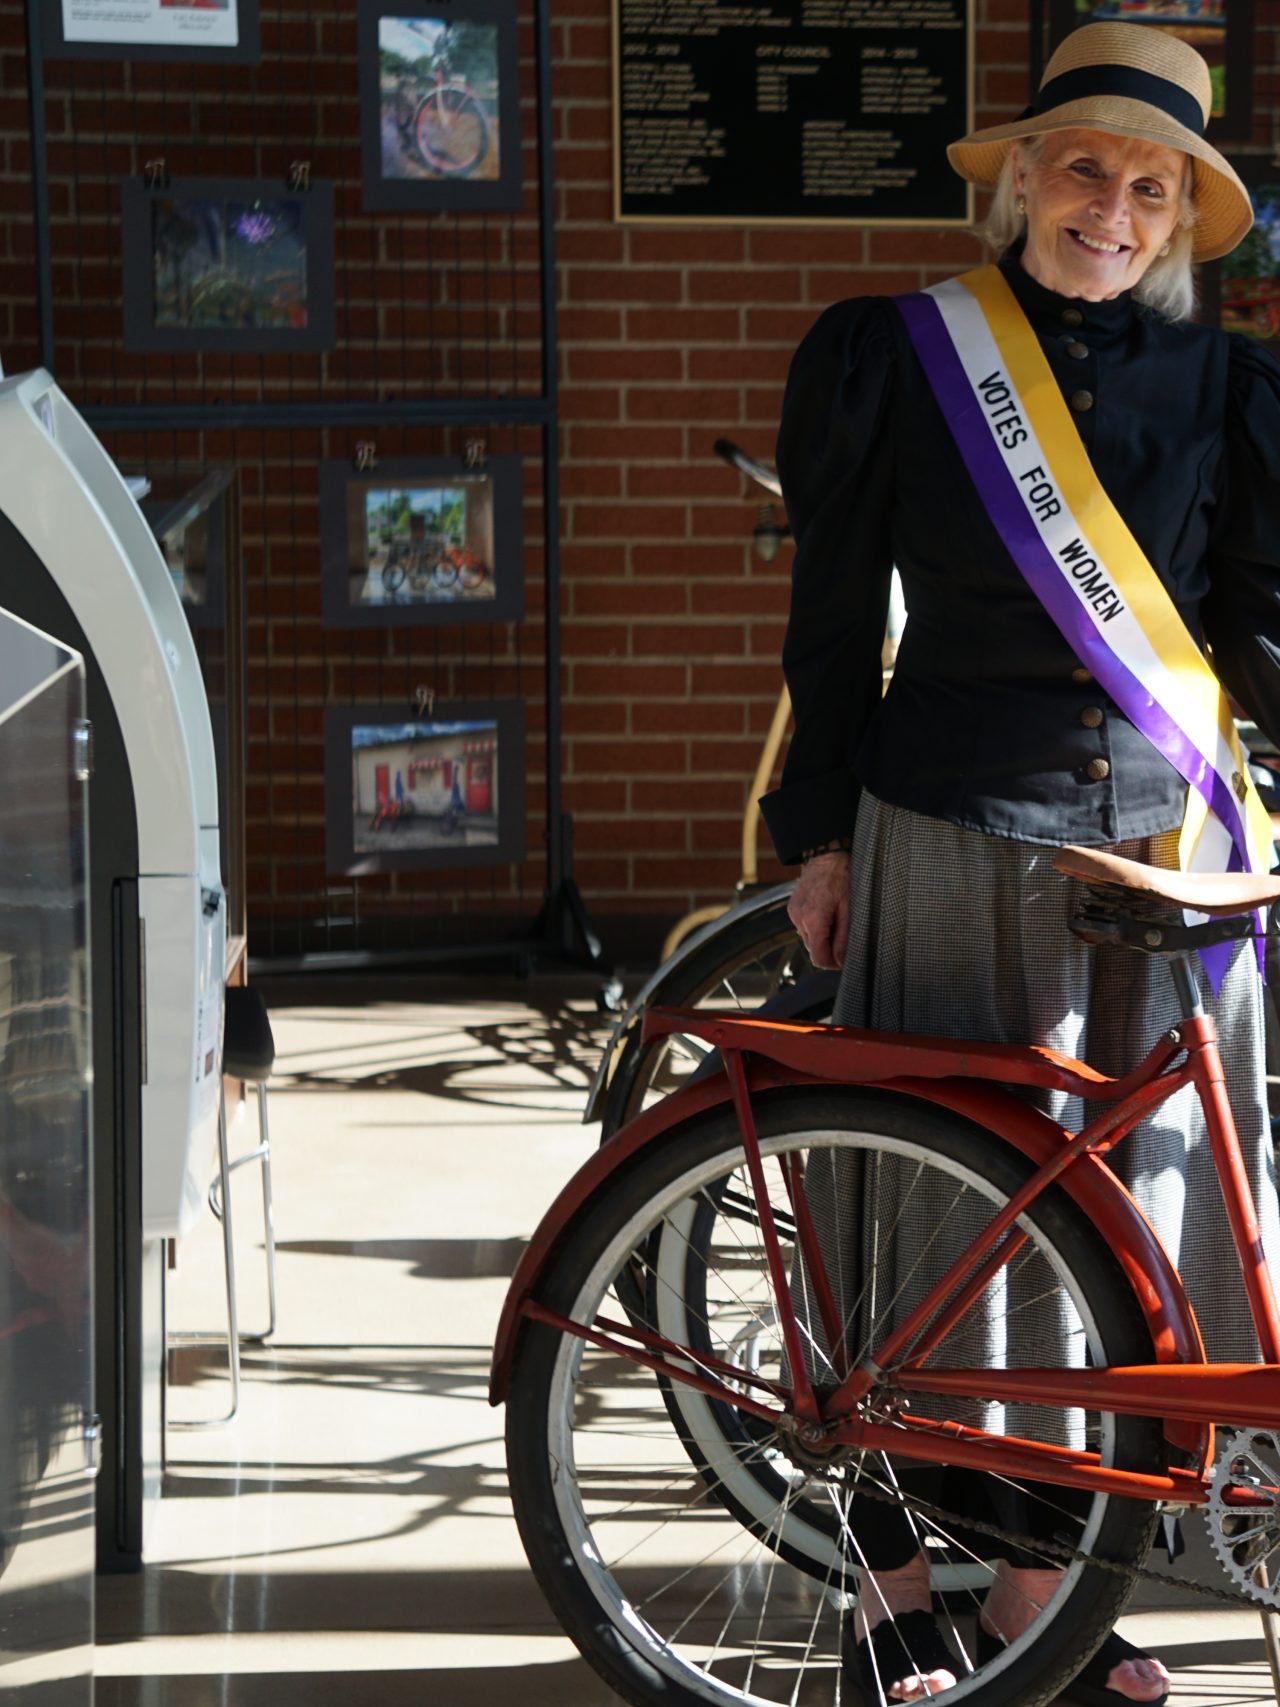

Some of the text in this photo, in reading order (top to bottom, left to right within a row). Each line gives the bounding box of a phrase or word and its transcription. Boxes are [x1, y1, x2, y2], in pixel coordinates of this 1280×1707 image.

[755, 46, 832, 59] CITY COUNCIL
[978, 370, 1125, 622] VOTES FOR WOMEN
